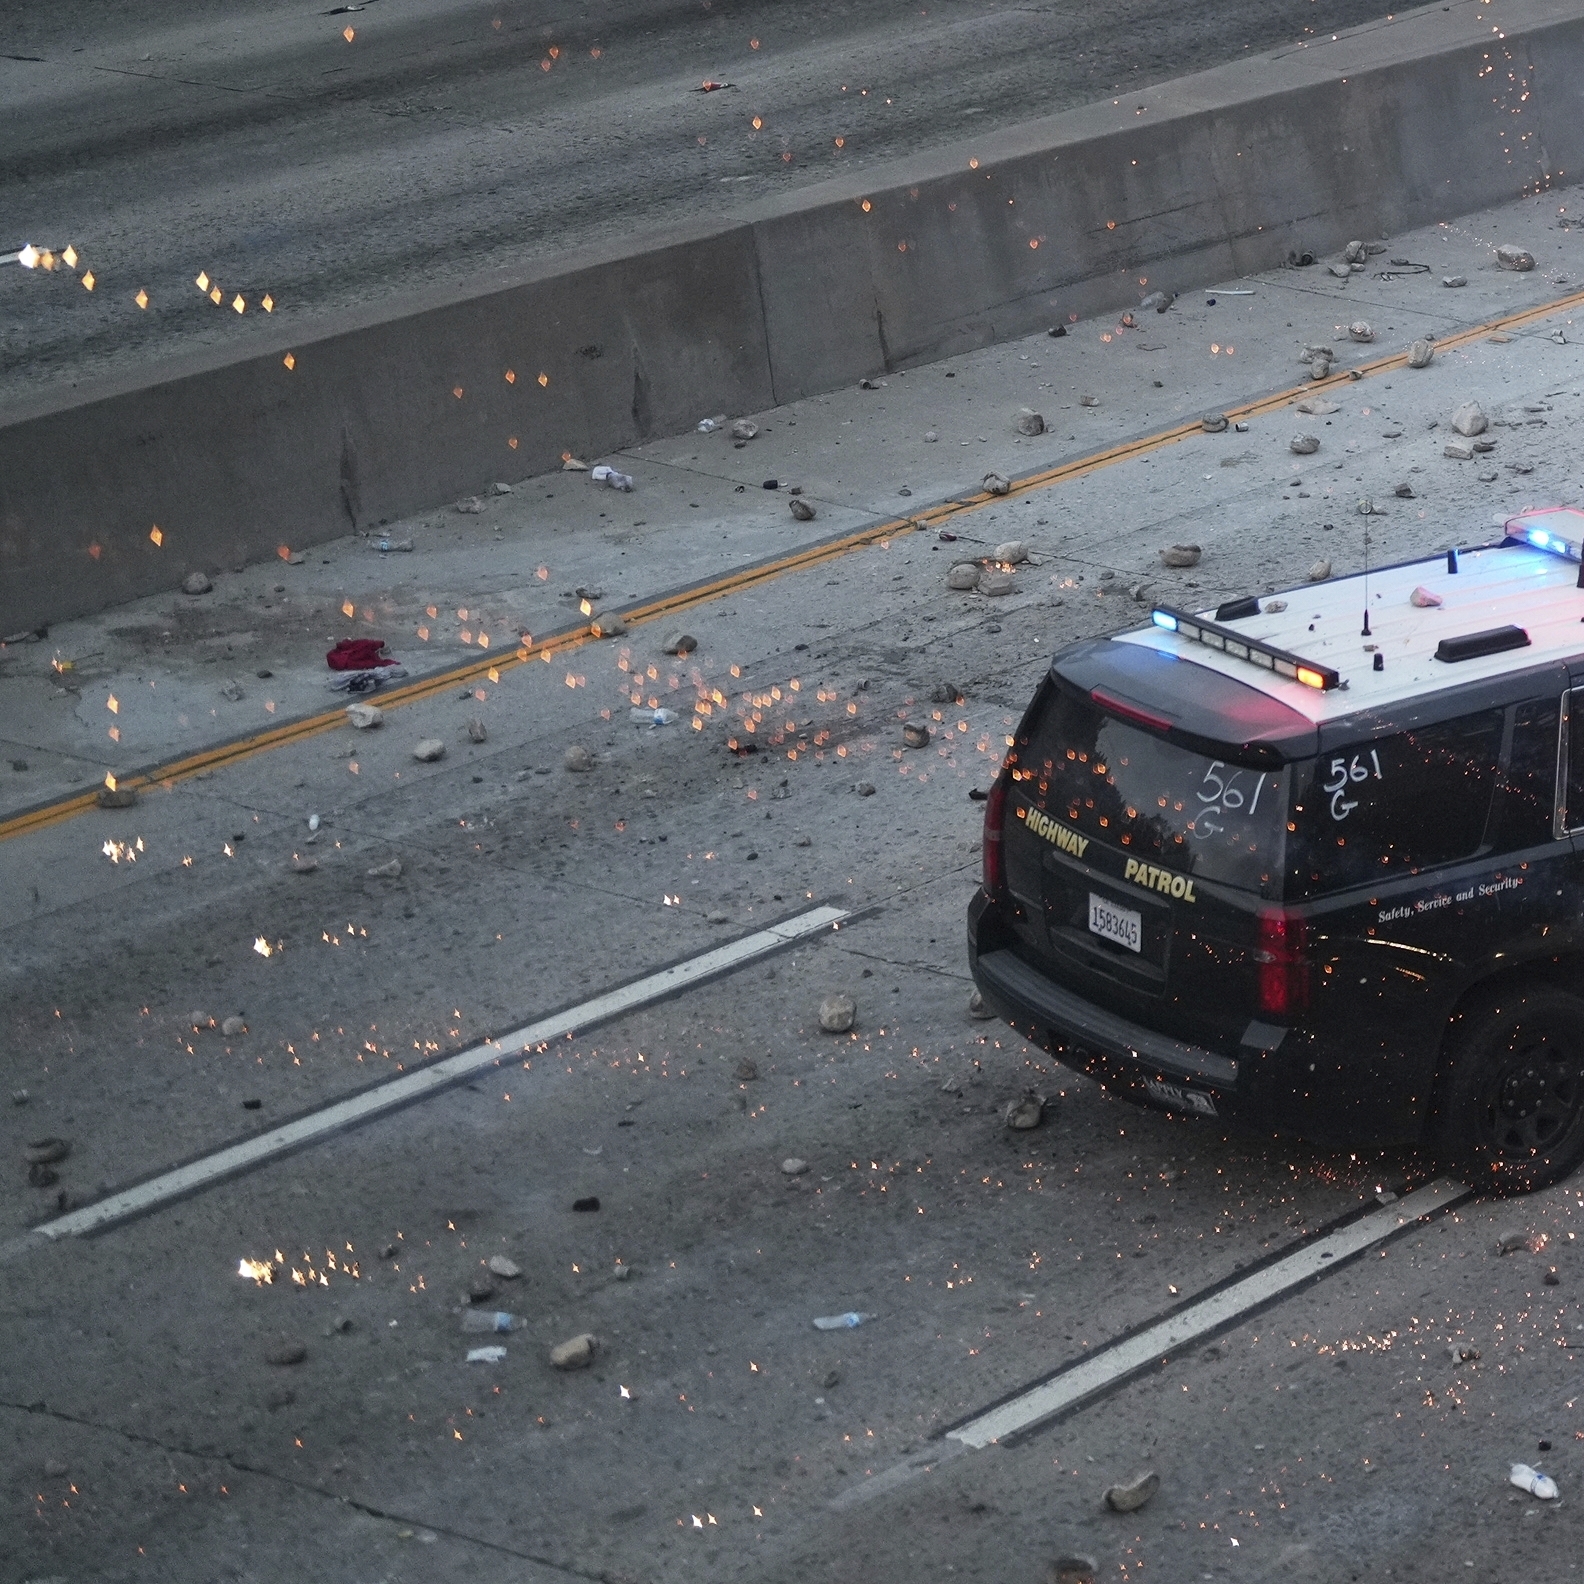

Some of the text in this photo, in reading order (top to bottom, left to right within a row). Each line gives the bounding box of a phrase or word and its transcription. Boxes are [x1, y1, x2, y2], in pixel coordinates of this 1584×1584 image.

[1196, 761, 1267, 815] 561
[1323, 748, 1383, 792] 561
[1025, 807, 1196, 903] HIGHWAY PATROL
[1378, 876, 1519, 923] Safety, Service and Security
[1092, 906, 1138, 944] 1583645
